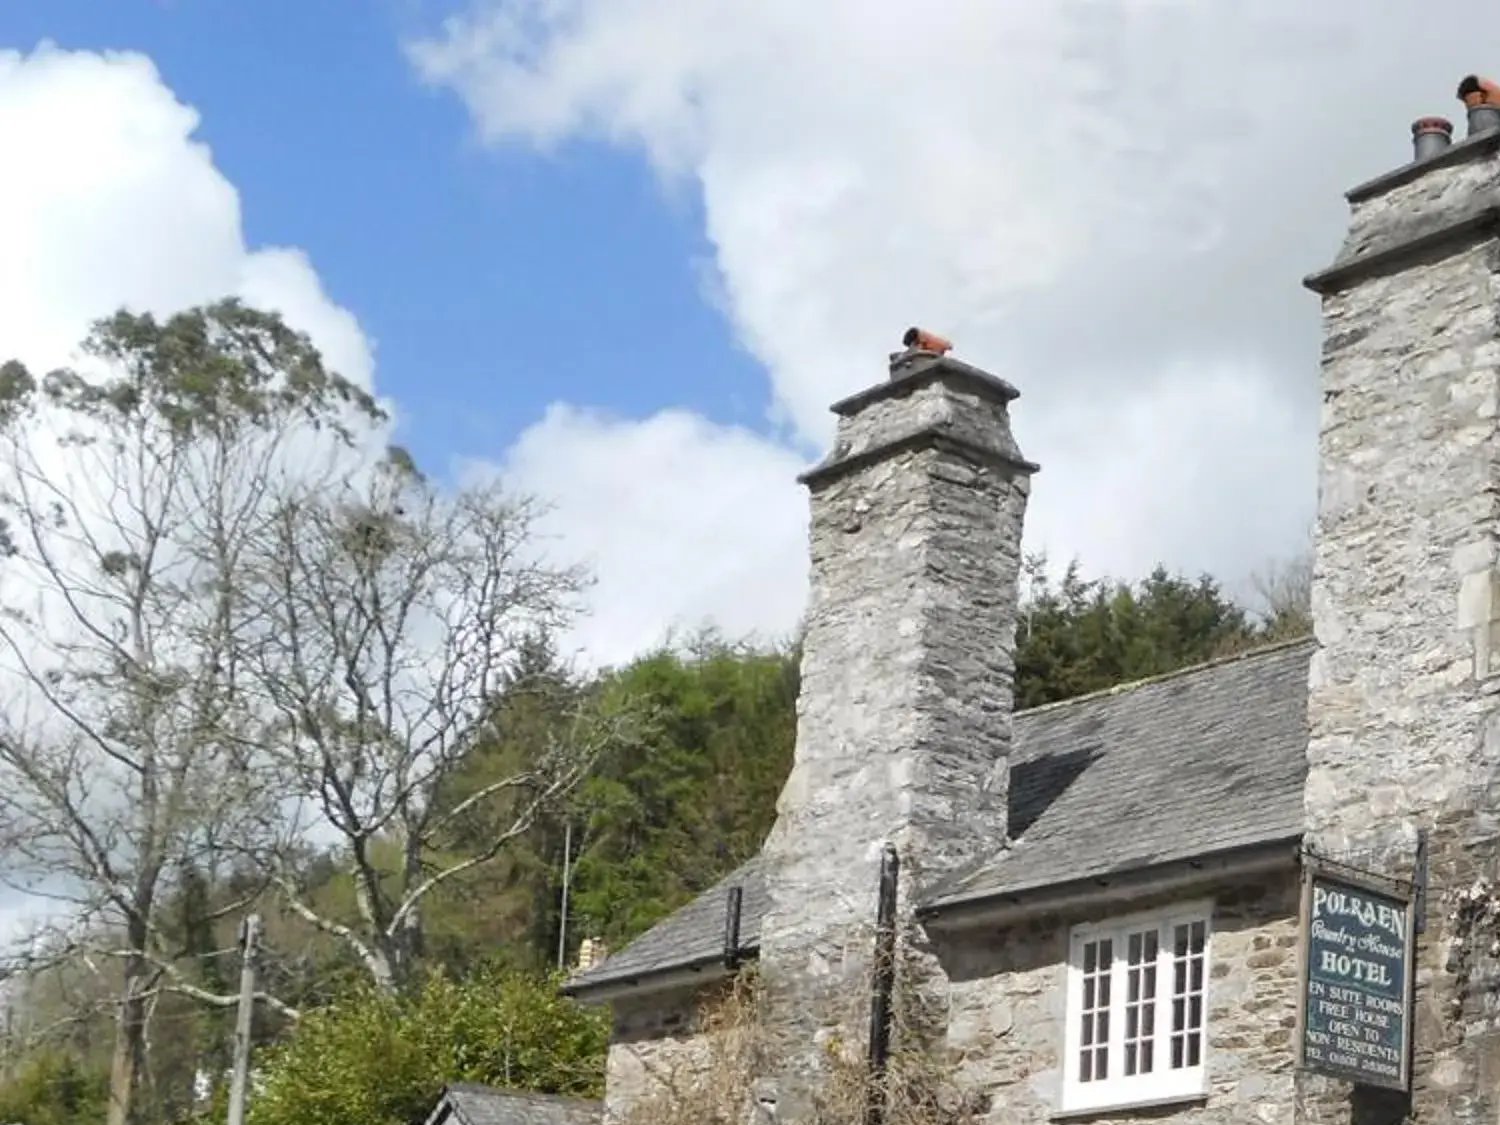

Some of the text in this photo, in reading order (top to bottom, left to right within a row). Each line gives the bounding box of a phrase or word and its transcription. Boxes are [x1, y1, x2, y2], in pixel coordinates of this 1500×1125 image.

[1313, 886, 1405, 940] POLRAEN
[1312, 920, 1356, 952] Country
[1322, 951, 1392, 985] HOTEL
[1310, 981, 1403, 1015] EN SUITE ROOMS
[1320, 1000, 1390, 1028] FREE HOUSE
[1329, 1020, 1379, 1041] OPEN TO
